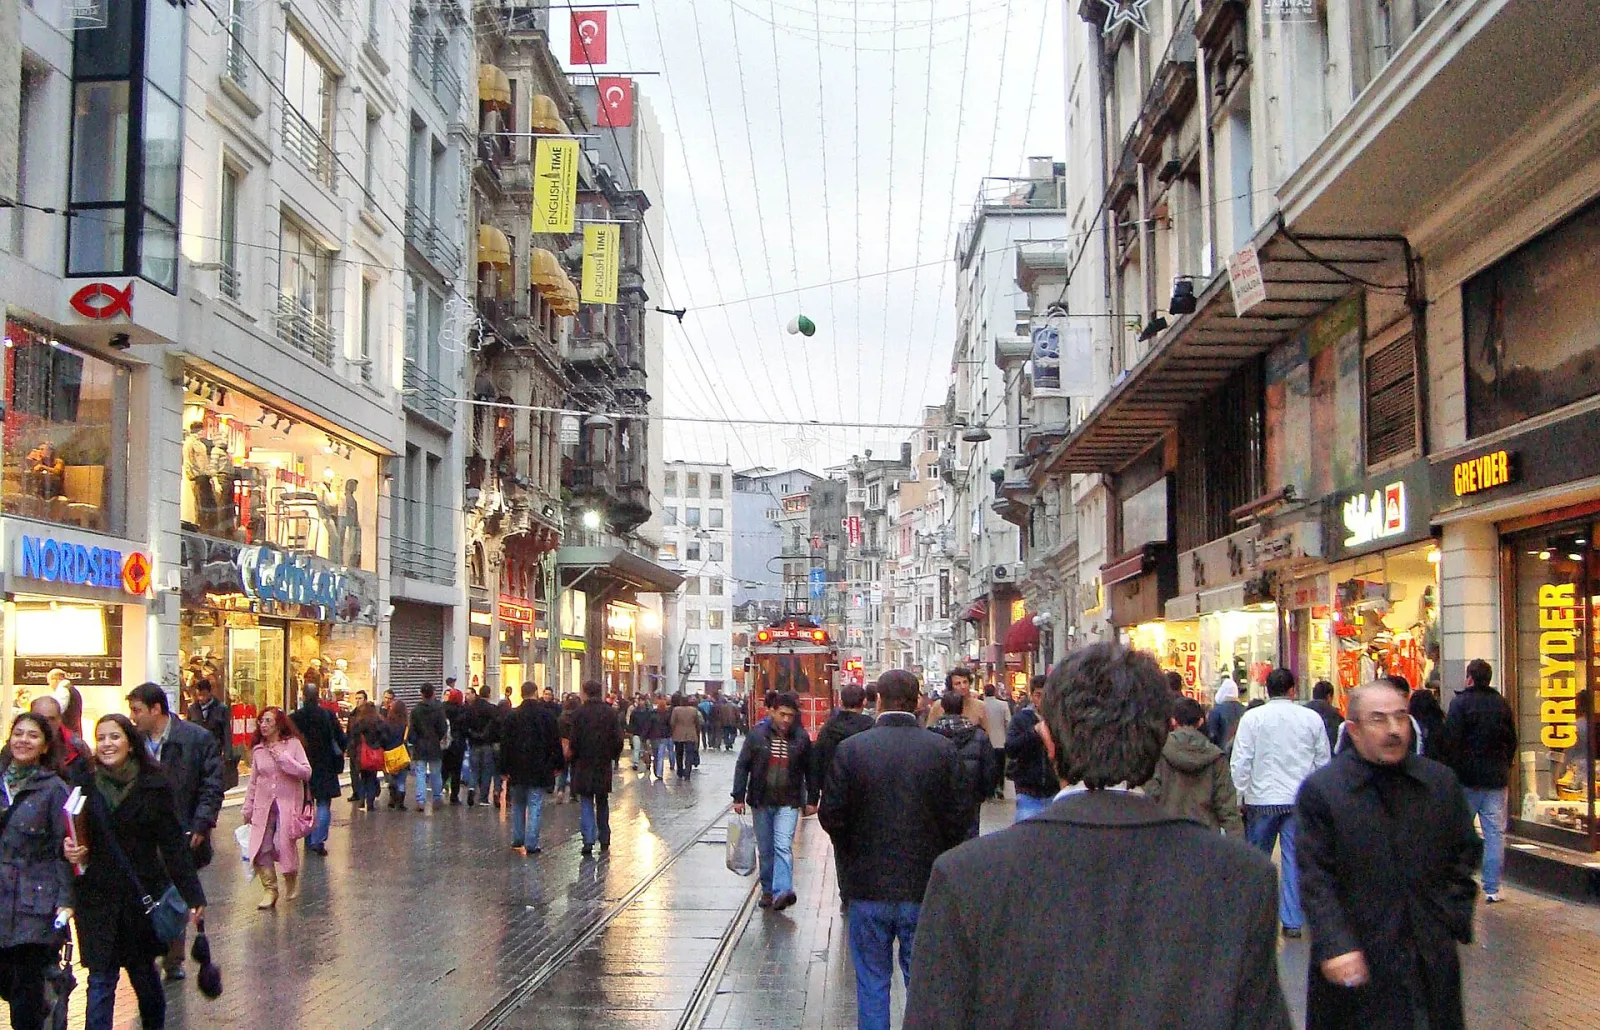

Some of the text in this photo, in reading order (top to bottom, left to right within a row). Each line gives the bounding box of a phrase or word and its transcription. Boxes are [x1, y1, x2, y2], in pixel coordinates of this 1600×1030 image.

[548, 146, 562, 225] ENGLISH TIME
[595, 230, 606, 298] ENGLISH TIME
[1454, 450, 1509, 497] GREYDER
[22, 535, 122, 588] NORDSEE
[789, 621, 795, 630] 3
[1539, 582, 1578, 749] GREYDER
